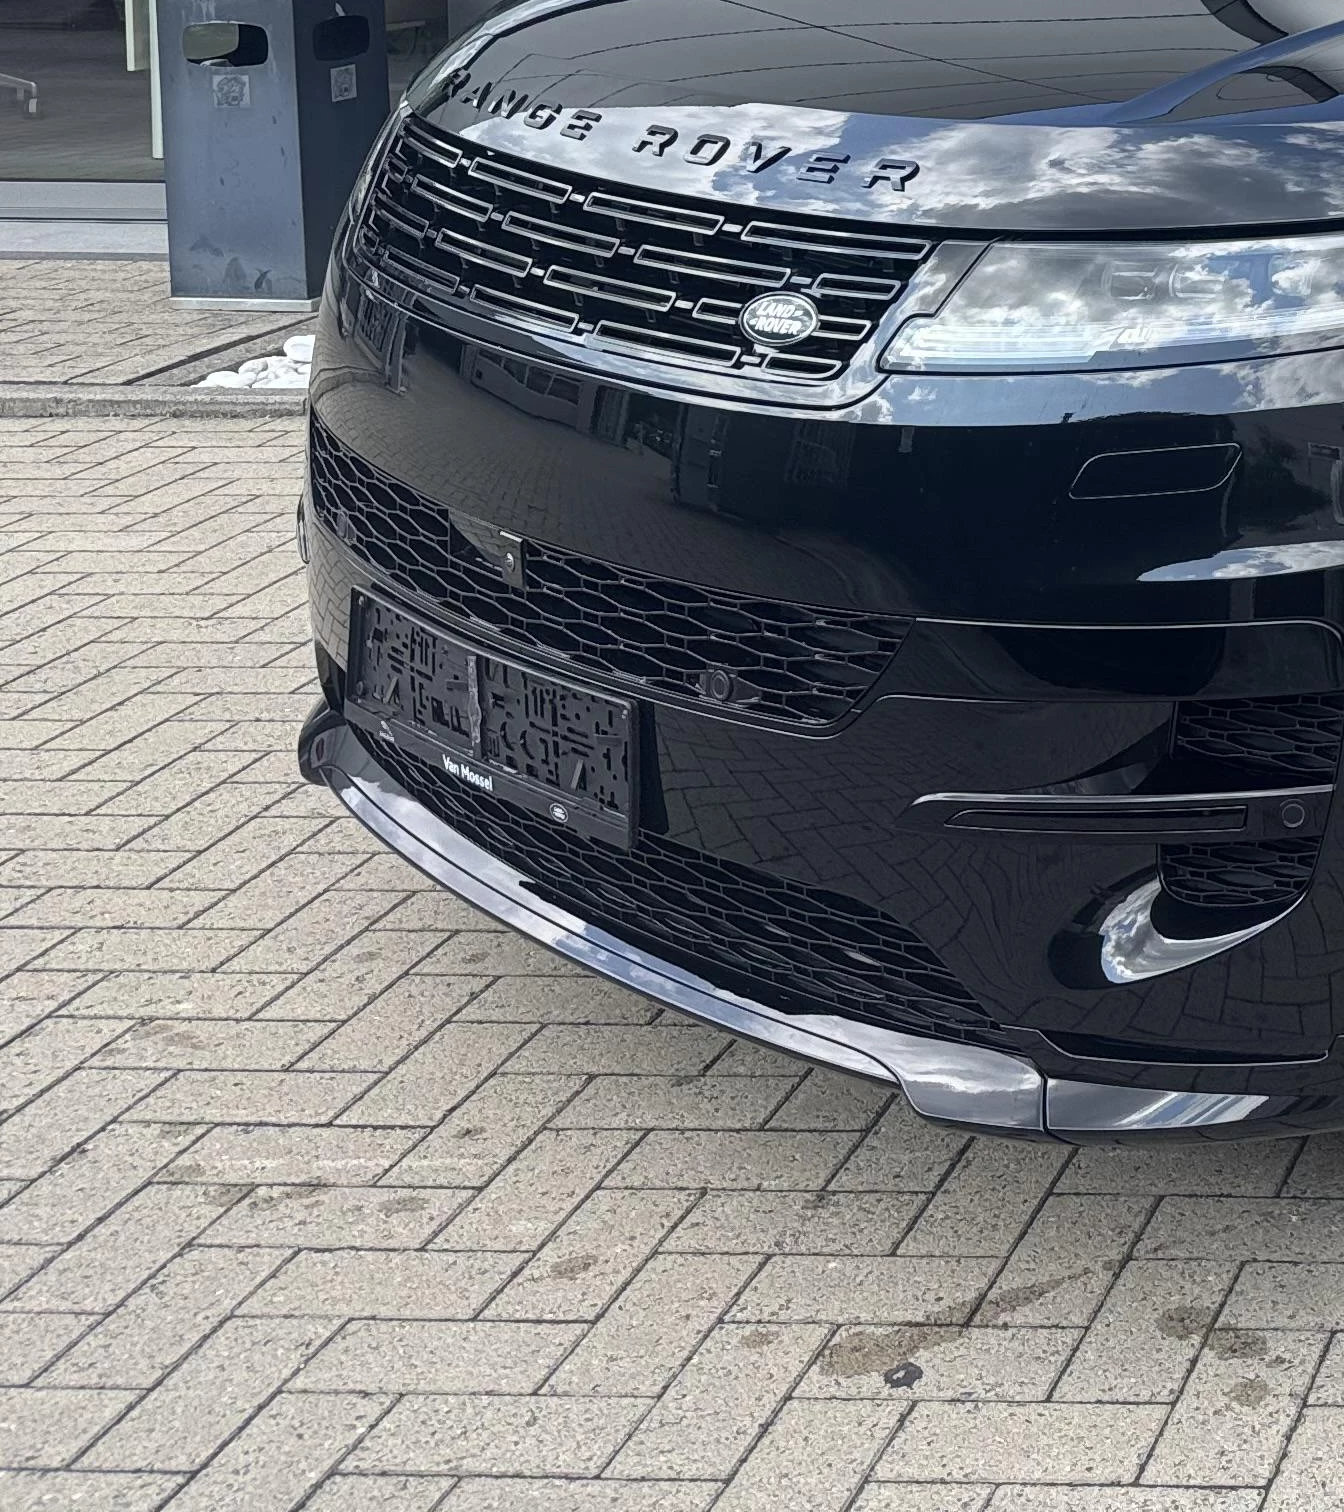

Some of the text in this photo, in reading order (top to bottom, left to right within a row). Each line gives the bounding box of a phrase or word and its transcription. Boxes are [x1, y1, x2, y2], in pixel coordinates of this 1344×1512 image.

[443, 71, 921, 192] RANGE ROVER
[756, 301, 796, 319] LAND
[755, 316, 802, 336] ROVER
[442, 753, 493, 792] Van Mossel
